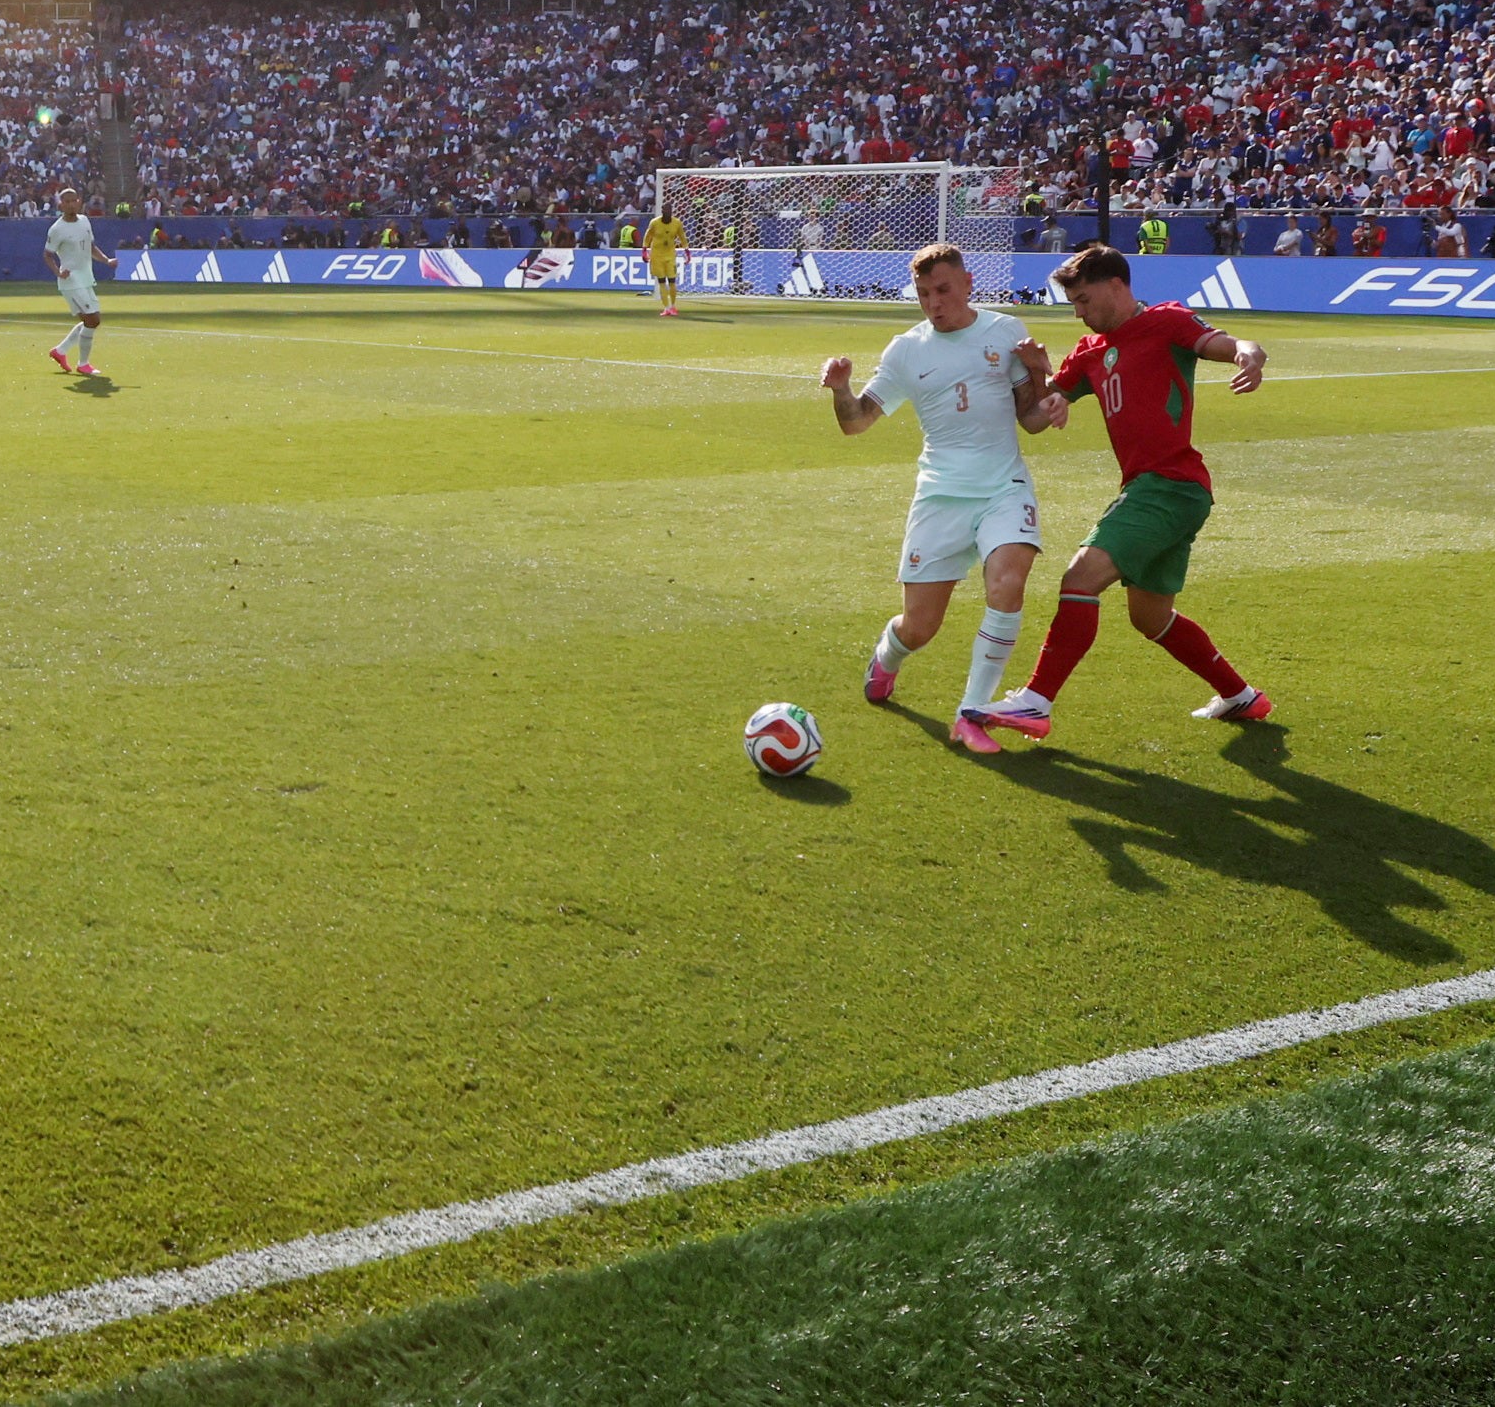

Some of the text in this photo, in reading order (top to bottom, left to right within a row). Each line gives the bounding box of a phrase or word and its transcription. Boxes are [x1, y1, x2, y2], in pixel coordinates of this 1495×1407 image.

[321, 254, 406, 281] F50
[955, 381, 970, 412] 3
[1101, 372, 1123, 418] 10
[1023, 504, 1037, 527] 3
